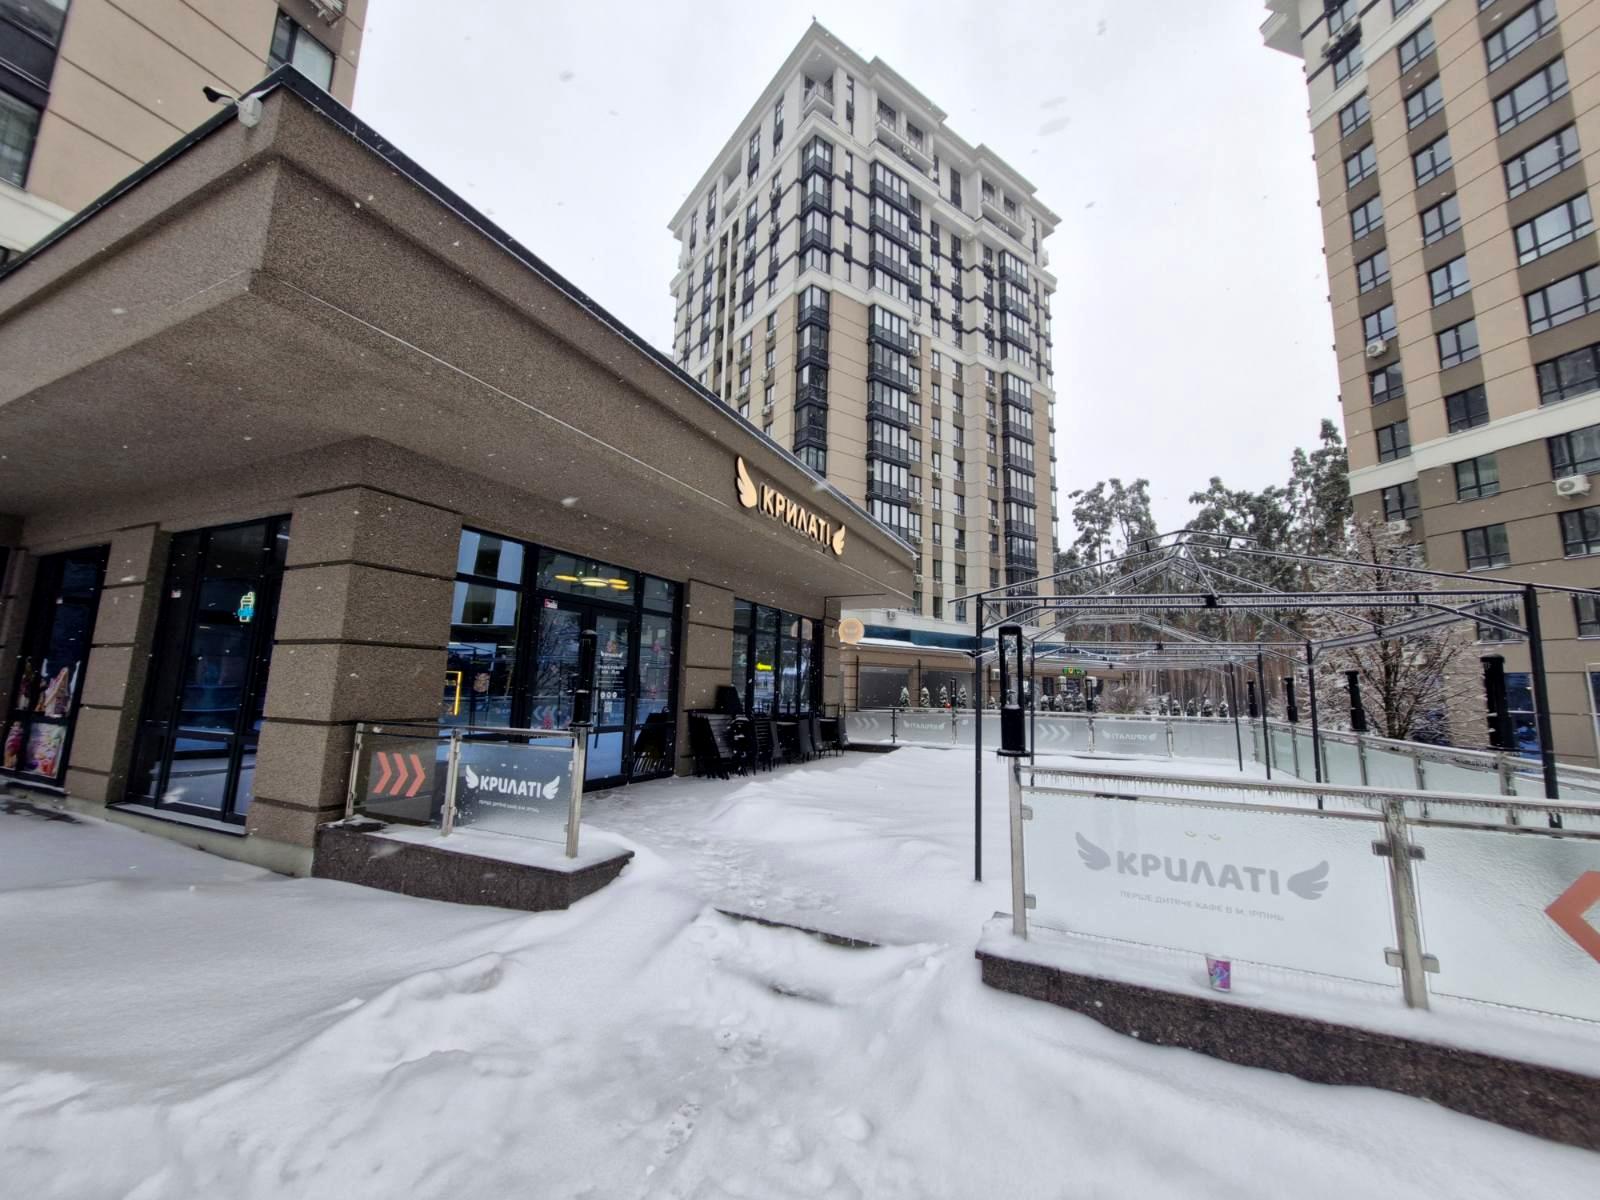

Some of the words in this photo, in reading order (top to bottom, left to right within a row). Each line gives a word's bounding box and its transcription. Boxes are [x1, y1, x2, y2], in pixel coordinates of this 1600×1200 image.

[763, 485, 831, 545] КРИЛАТІ
[480, 775, 542, 798] КРИЛАТІ
[1116, 850, 1280, 895] КРИЛАТІ
